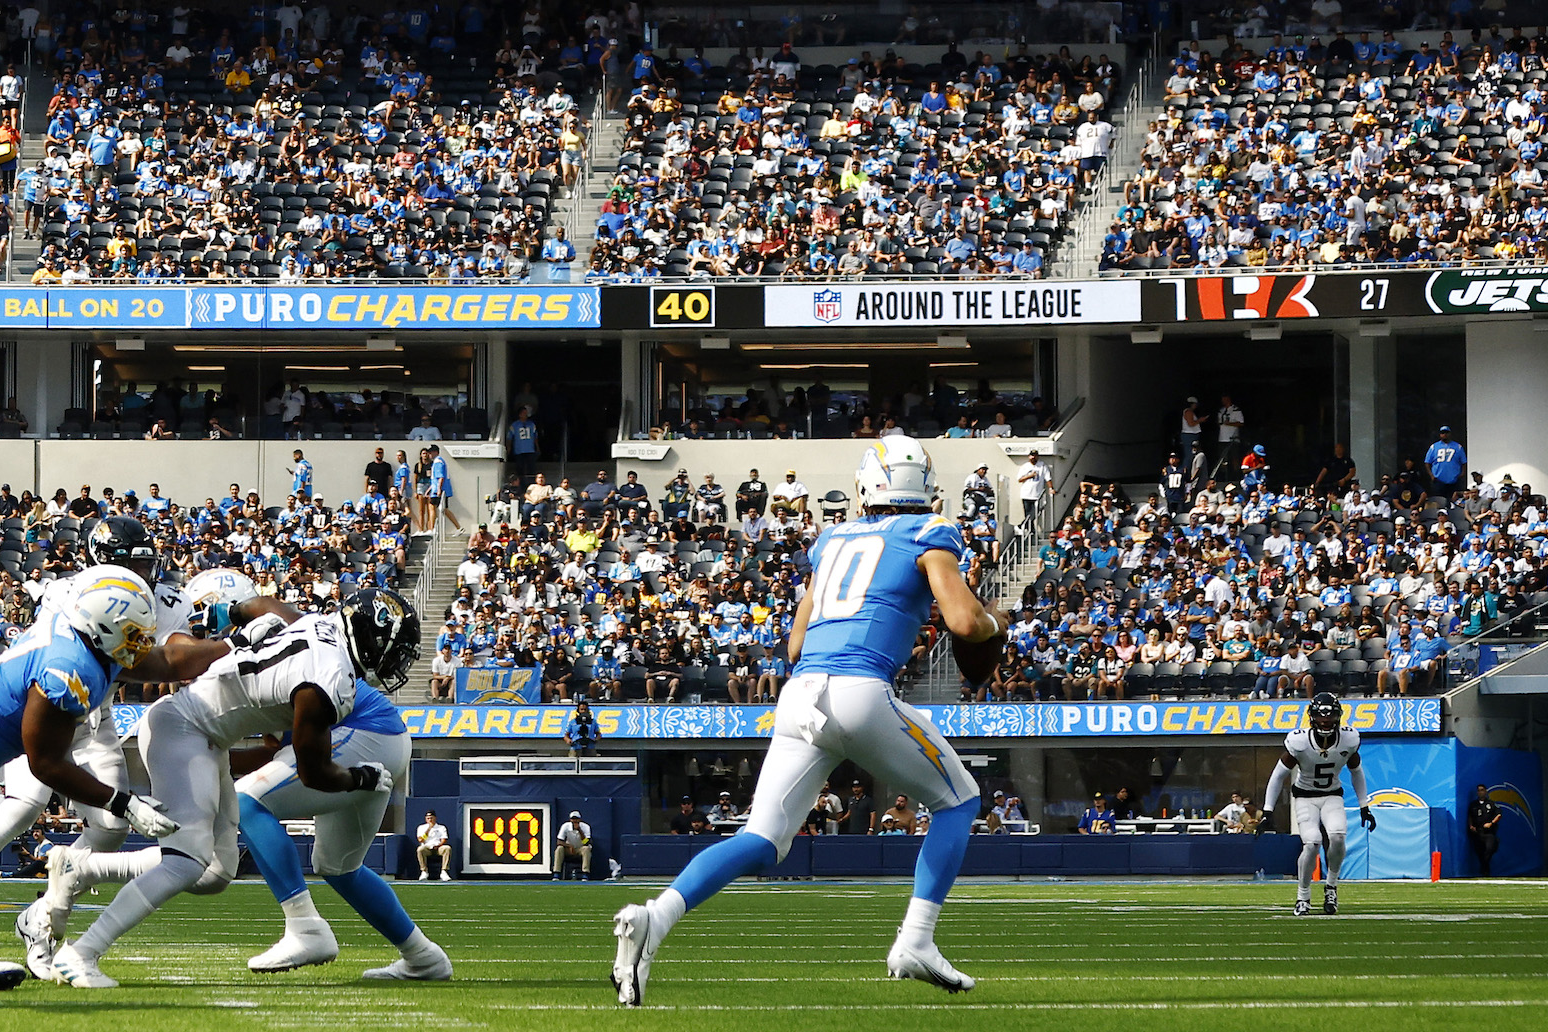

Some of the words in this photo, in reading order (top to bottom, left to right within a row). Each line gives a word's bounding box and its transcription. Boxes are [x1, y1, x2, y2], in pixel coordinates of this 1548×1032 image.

[411, 14, 422, 26] 10
[1477, 82, 1492, 95] 33
[1086, 127, 1099, 138] 21
[1360, 279, 1390, 310] 27
[4, 297, 73, 319] BALL
[80, 297, 119, 319] ON
[131, 297, 166, 319] 20
[657, 292, 711, 321] 40
[817, 303, 840, 320] NFL
[856, 291, 944, 321] AROUND
[952, 290, 993, 320] THE
[1002, 288, 1083, 319] LEAGUE
[519, 427, 532, 440] 21
[1437, 449, 1456, 463] 97
[1168, 473, 1182, 489] 10
[312, 513, 326, 529] 10
[214, 574, 236, 589] 79
[809, 535, 885, 623] 10
[104, 597, 130, 616] 77
[467, 668, 506, 692] BOLT
[510, 670, 534, 691] UP
[1314, 763, 1334, 789] 5
[473, 812, 540, 861] 40
